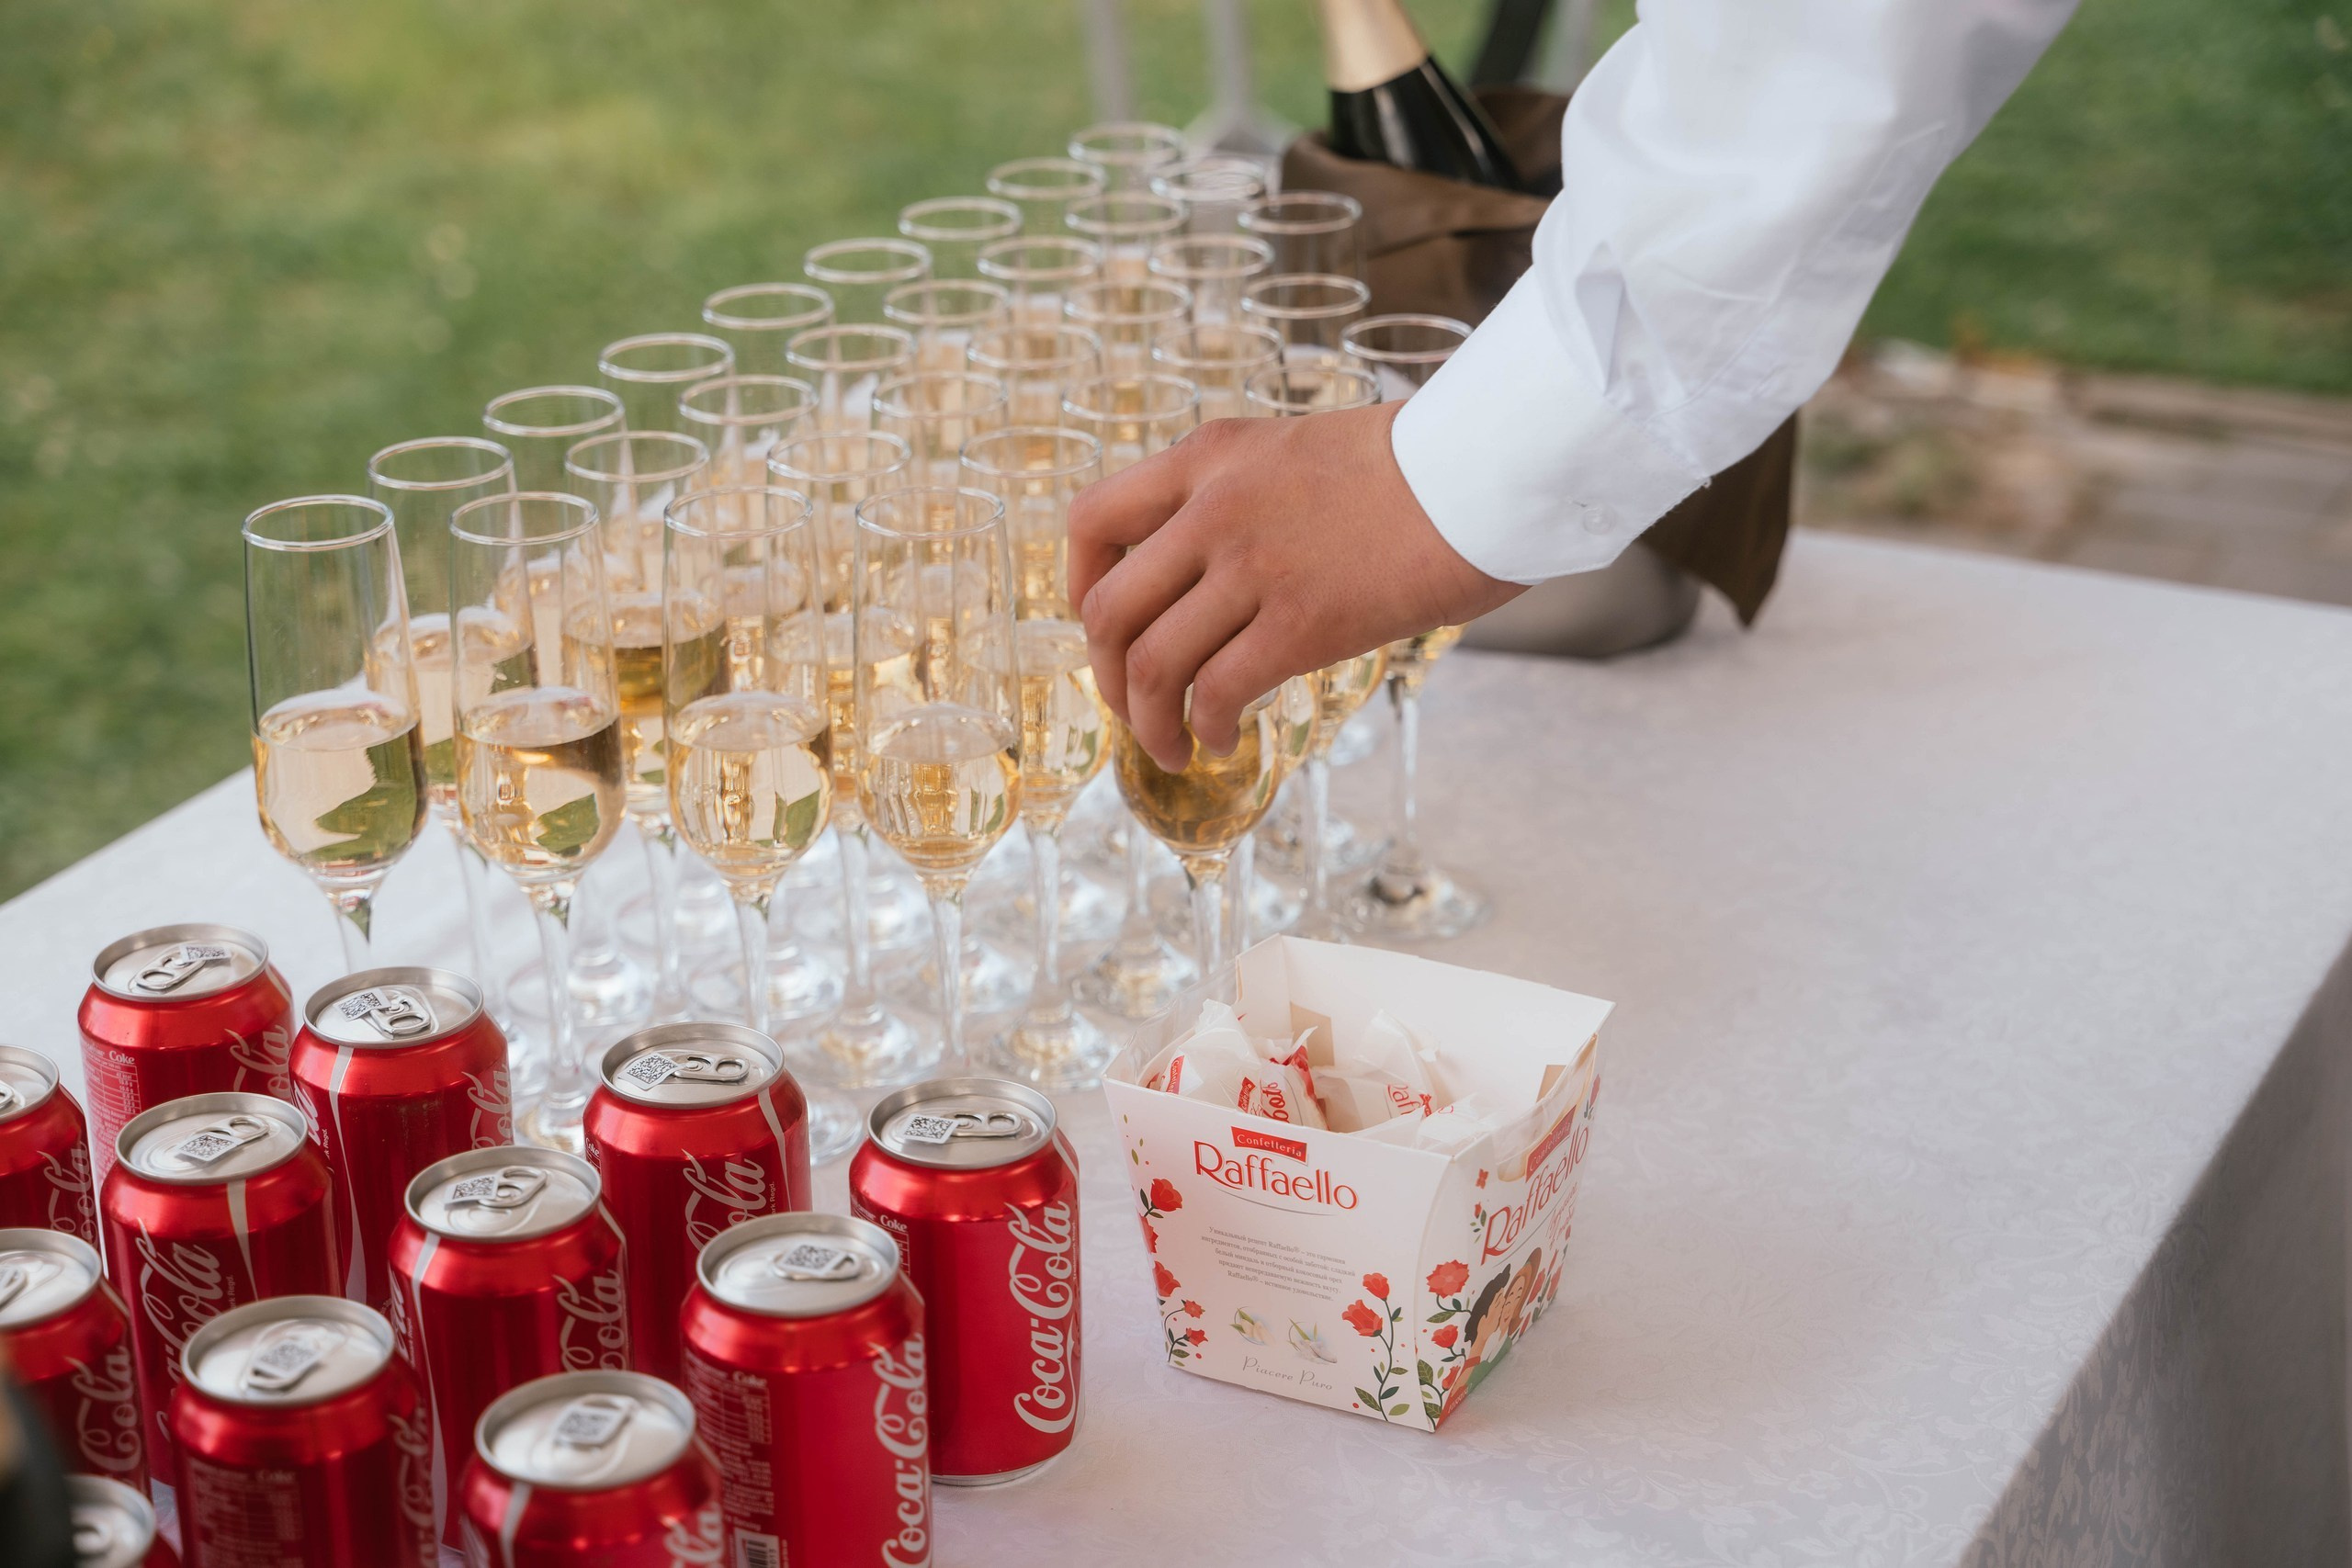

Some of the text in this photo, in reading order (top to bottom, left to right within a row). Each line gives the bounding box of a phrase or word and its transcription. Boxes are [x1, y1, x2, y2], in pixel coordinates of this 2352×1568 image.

[108, 1050, 135, 1065] Coke
[1237, 1134, 1302, 1157] Confetteria
[1193, 1140, 1358, 1210] Raffaello
[1481, 1125, 1589, 1266] Raffaello
[879, 1214, 908, 1232] Coke
[1004, 1200, 1077, 1434] Coca-Cola
[1242, 1356, 1333, 1391] Piacere Puro
